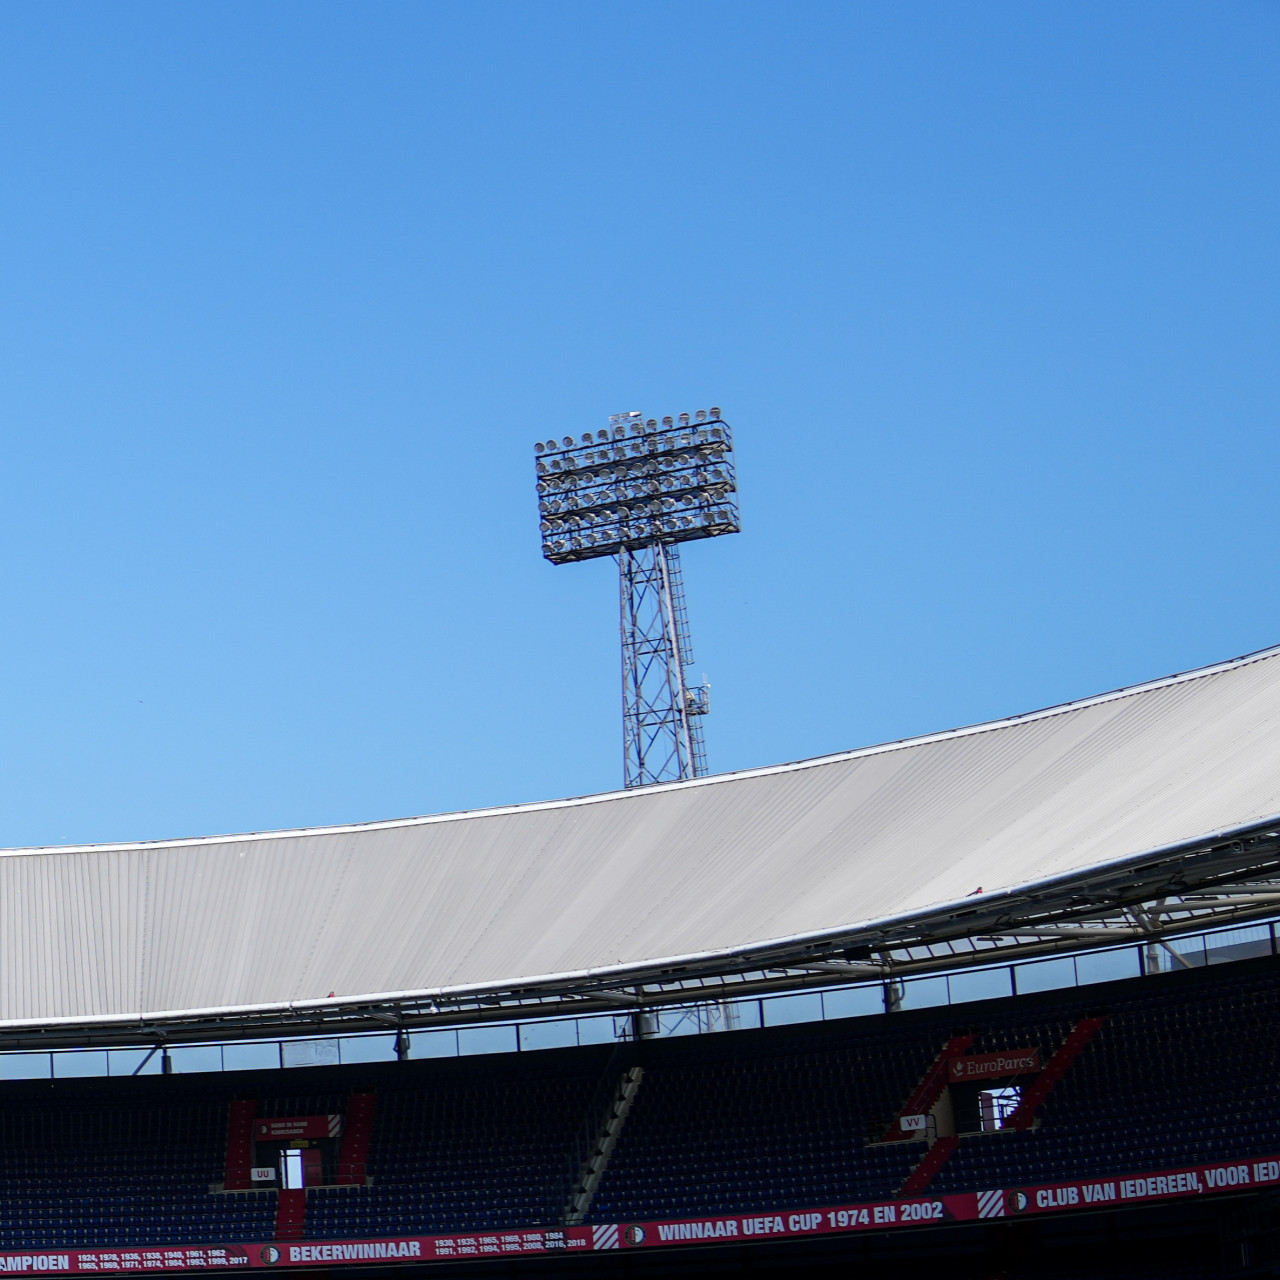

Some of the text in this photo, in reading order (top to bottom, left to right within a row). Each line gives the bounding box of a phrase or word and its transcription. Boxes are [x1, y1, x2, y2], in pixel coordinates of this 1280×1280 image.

[967, 1057, 1034, 1075] EuroParcs
[906, 1118, 920, 1127] VV
[257, 1169, 269, 1178] UU
[1036, 1160, 1280, 1208] CLUB VAN IEDEREEN, VOOR IED
[658, 1201, 943, 1241] WINNAAR UEFA CUP 1974 EN 2002
[290, 1241, 421, 1262] BEKERWINNAAR
